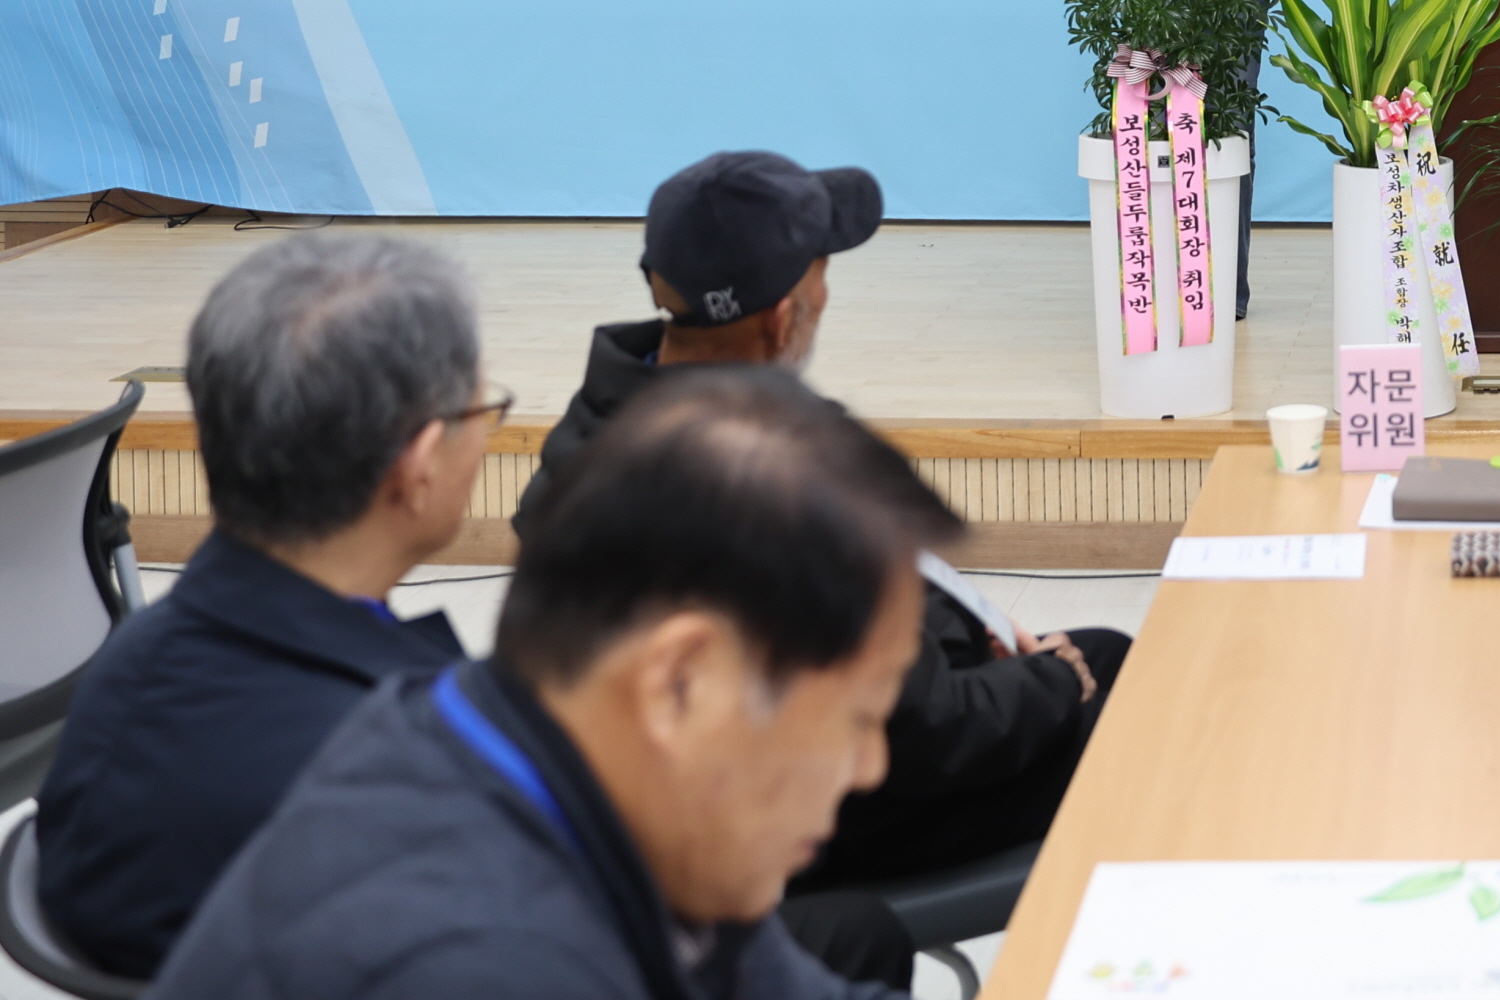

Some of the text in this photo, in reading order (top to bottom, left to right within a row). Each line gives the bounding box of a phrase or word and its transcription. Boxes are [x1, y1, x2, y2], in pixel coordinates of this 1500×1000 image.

[1173, 113, 1205, 311] 축 제7대회장 취임
[1384, 152, 1407, 269] 보성차생산자조합
[1395, 277, 1408, 308] 조합장
[1347, 369, 1416, 403] 자문
[1347, 412, 1416, 448] 위원
